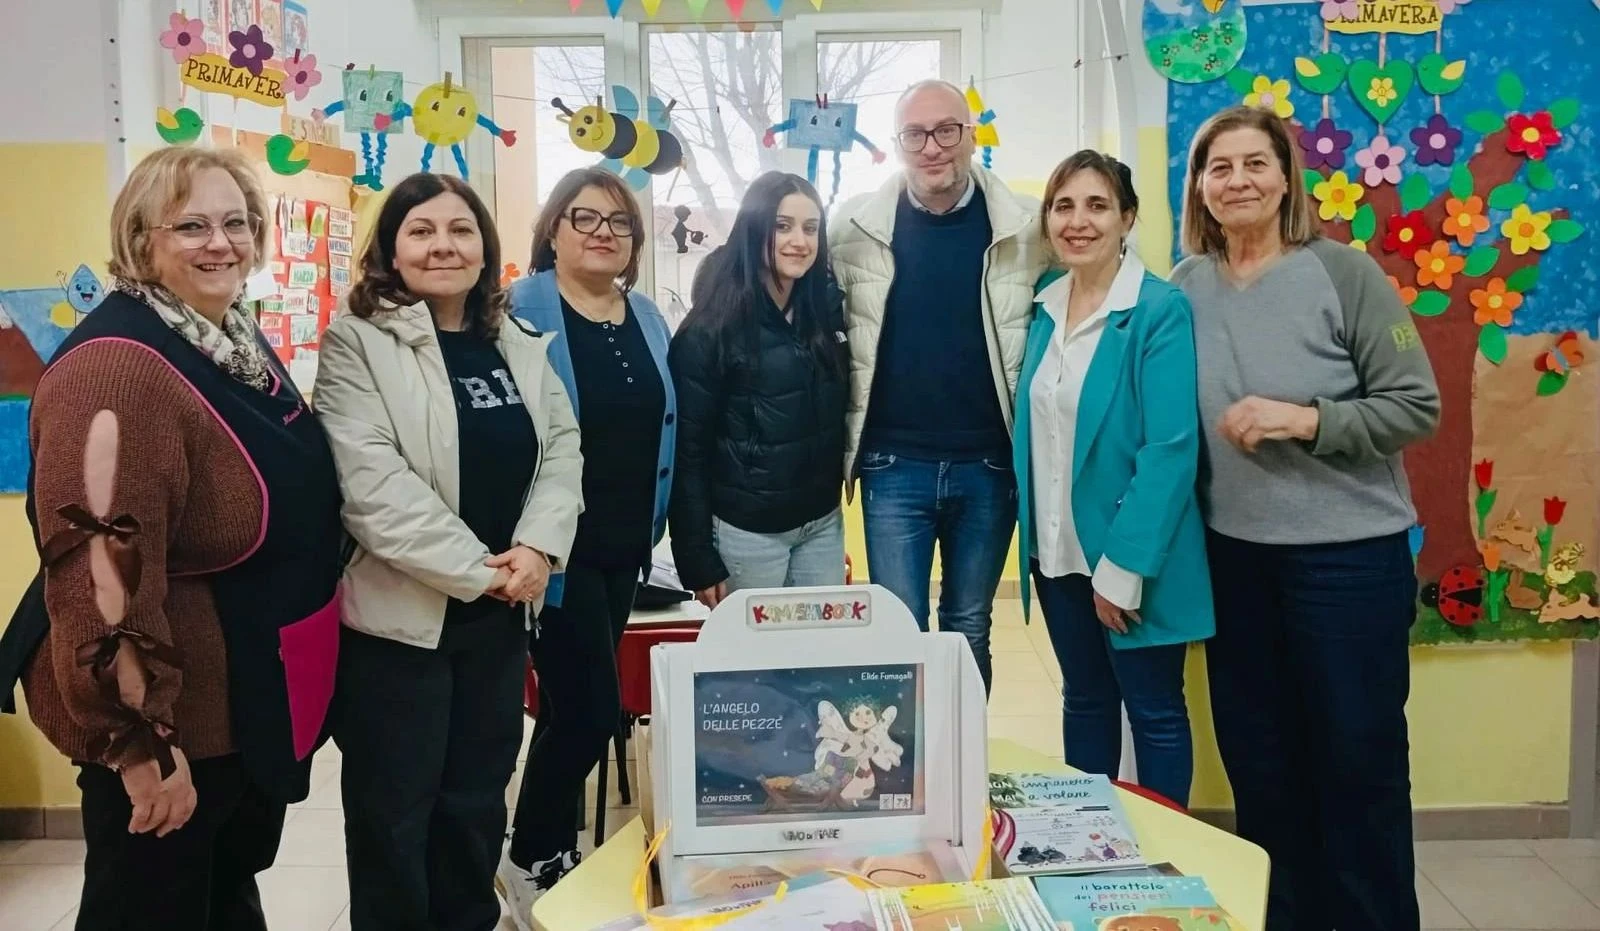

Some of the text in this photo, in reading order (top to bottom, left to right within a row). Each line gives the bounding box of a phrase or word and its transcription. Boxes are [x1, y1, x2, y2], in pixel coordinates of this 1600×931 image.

[1326, 4, 1438, 24] IMAVERA
[185, 58, 286, 100] PRIMAVER
[861, 671, 913, 681] Elide Fumagalli
[703, 702, 760, 715] L'ANGELO
[703, 717, 783, 731] DELLE PEZZE
[989, 781, 1013, 789] ON
[702, 795, 718, 804] CON
[1092, 882, 1164, 891] barattolo
[1098, 891, 1172, 902] pensieri
[1088, 902, 1137, 912] felici
